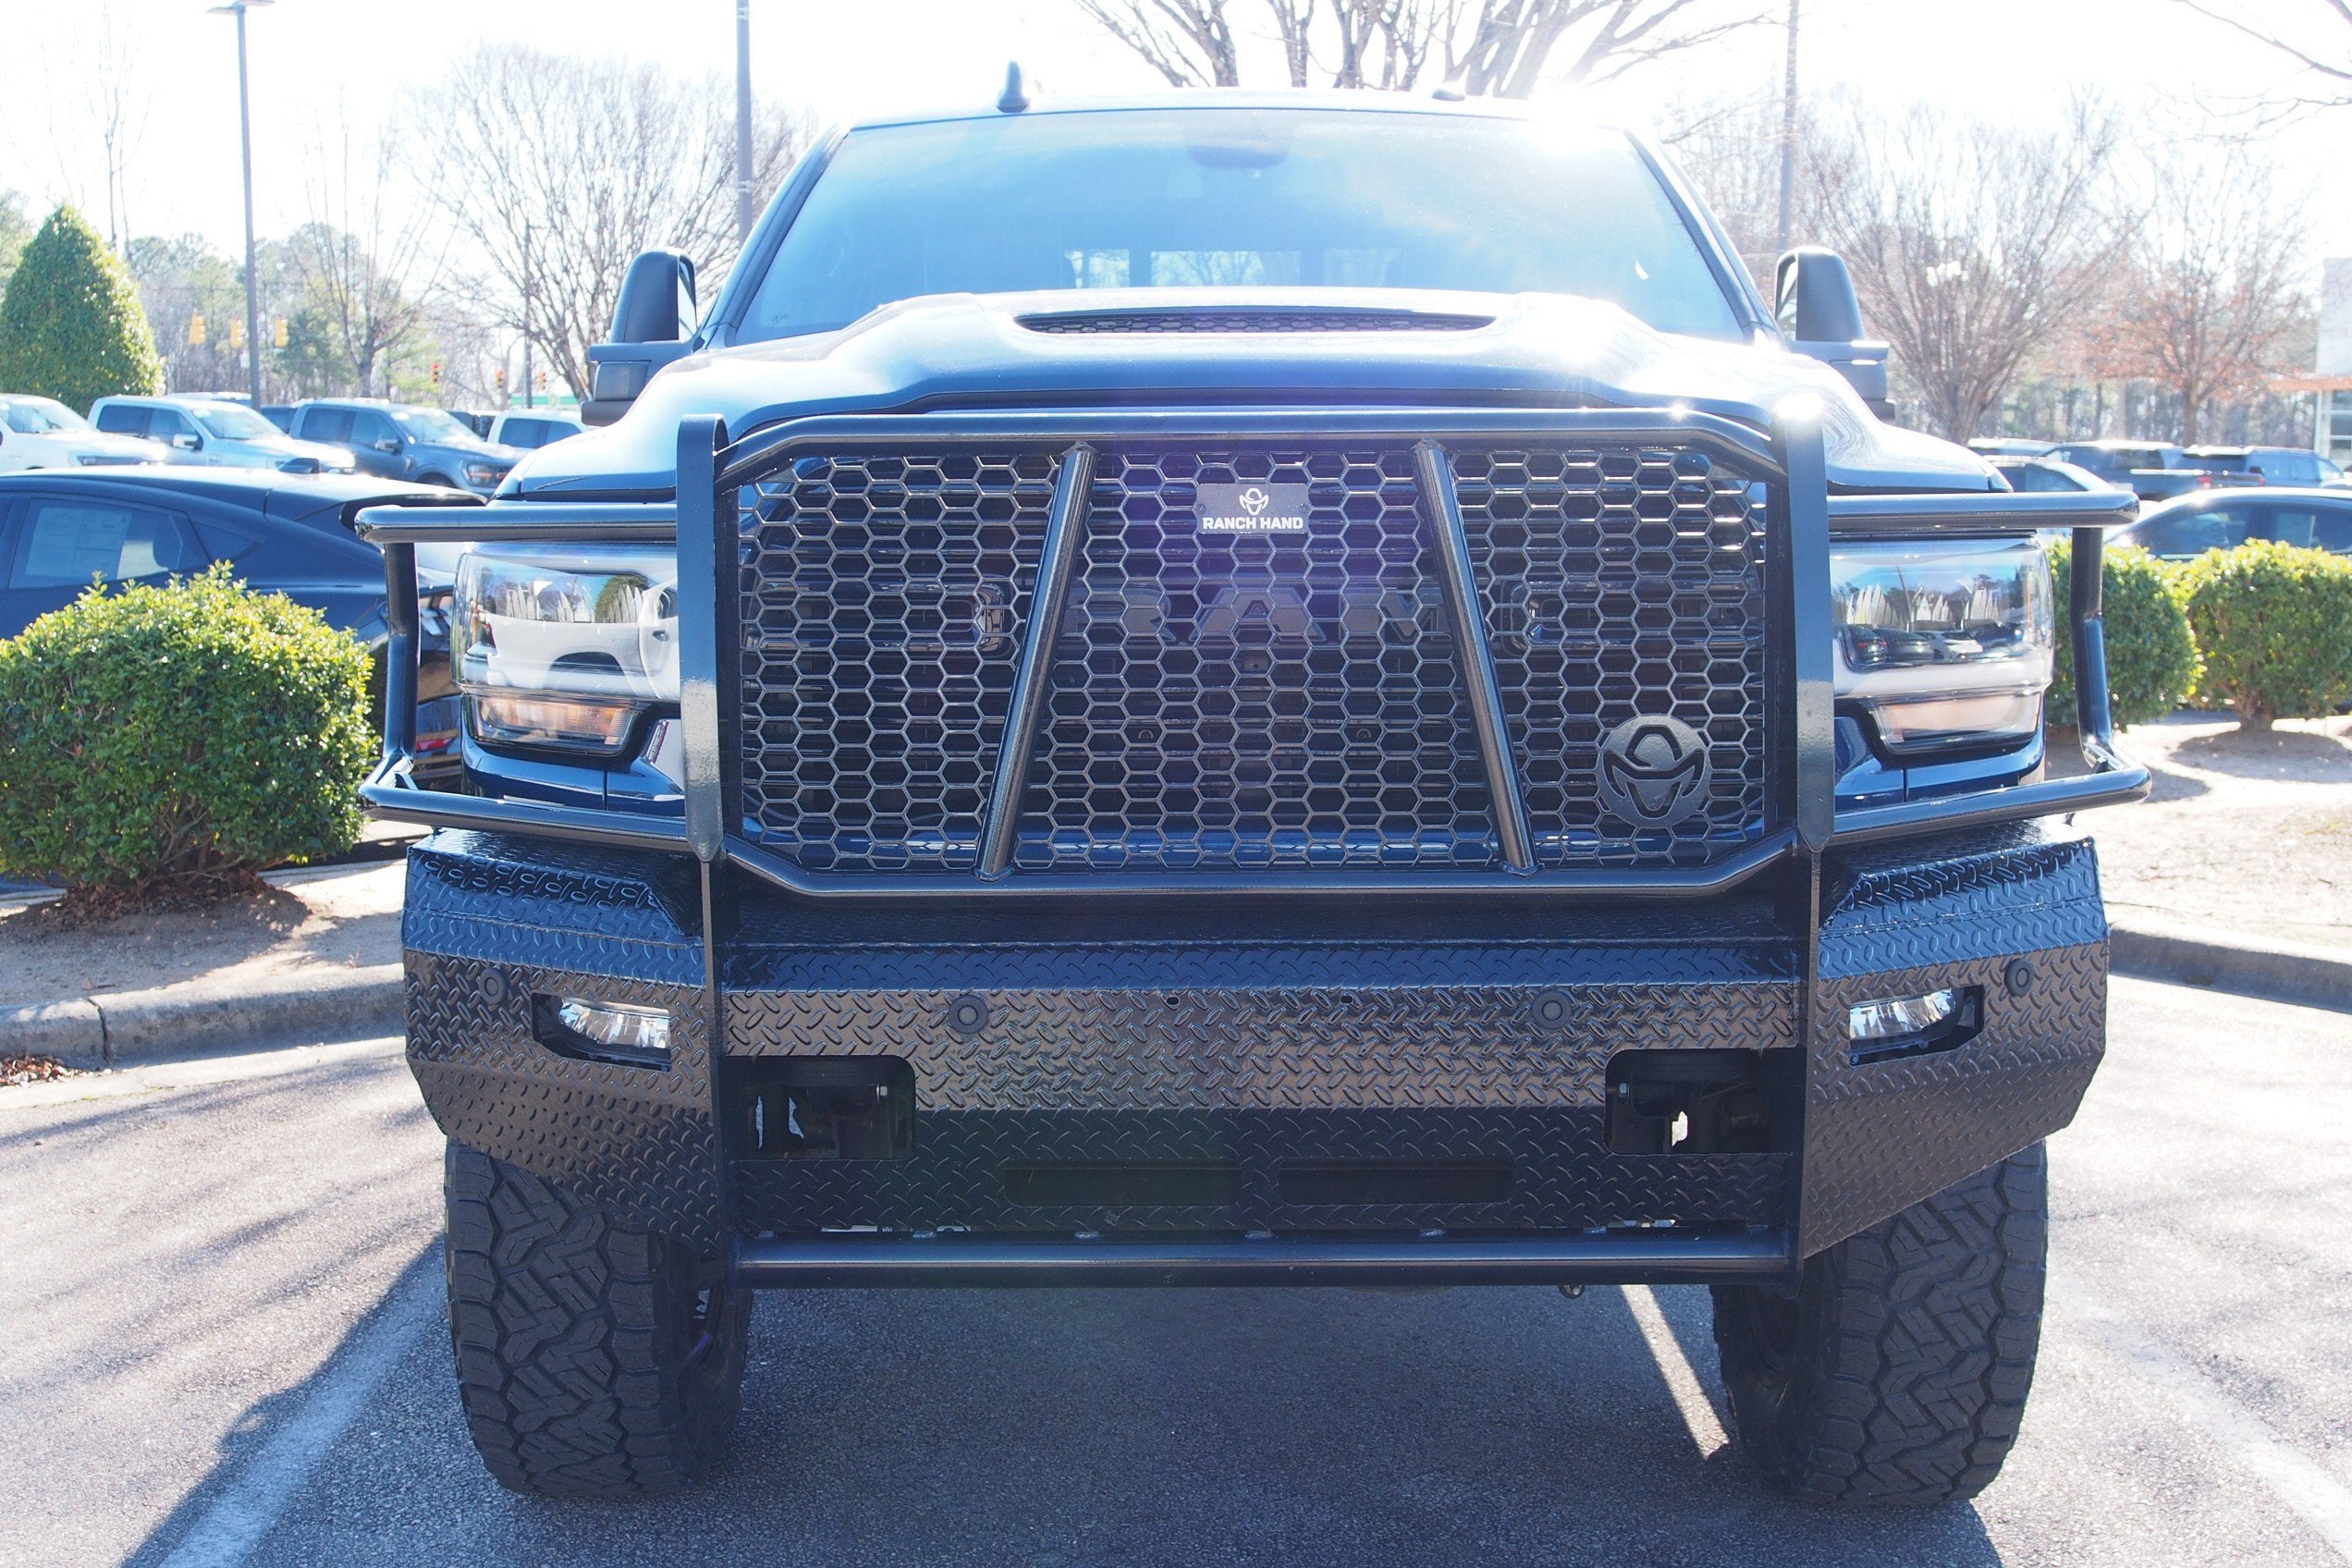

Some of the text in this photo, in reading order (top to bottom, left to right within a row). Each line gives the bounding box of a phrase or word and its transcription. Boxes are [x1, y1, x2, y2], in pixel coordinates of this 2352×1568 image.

[1203, 517, 1304, 530] RANCH HAND
[1063, 586, 1451, 642] RAM
